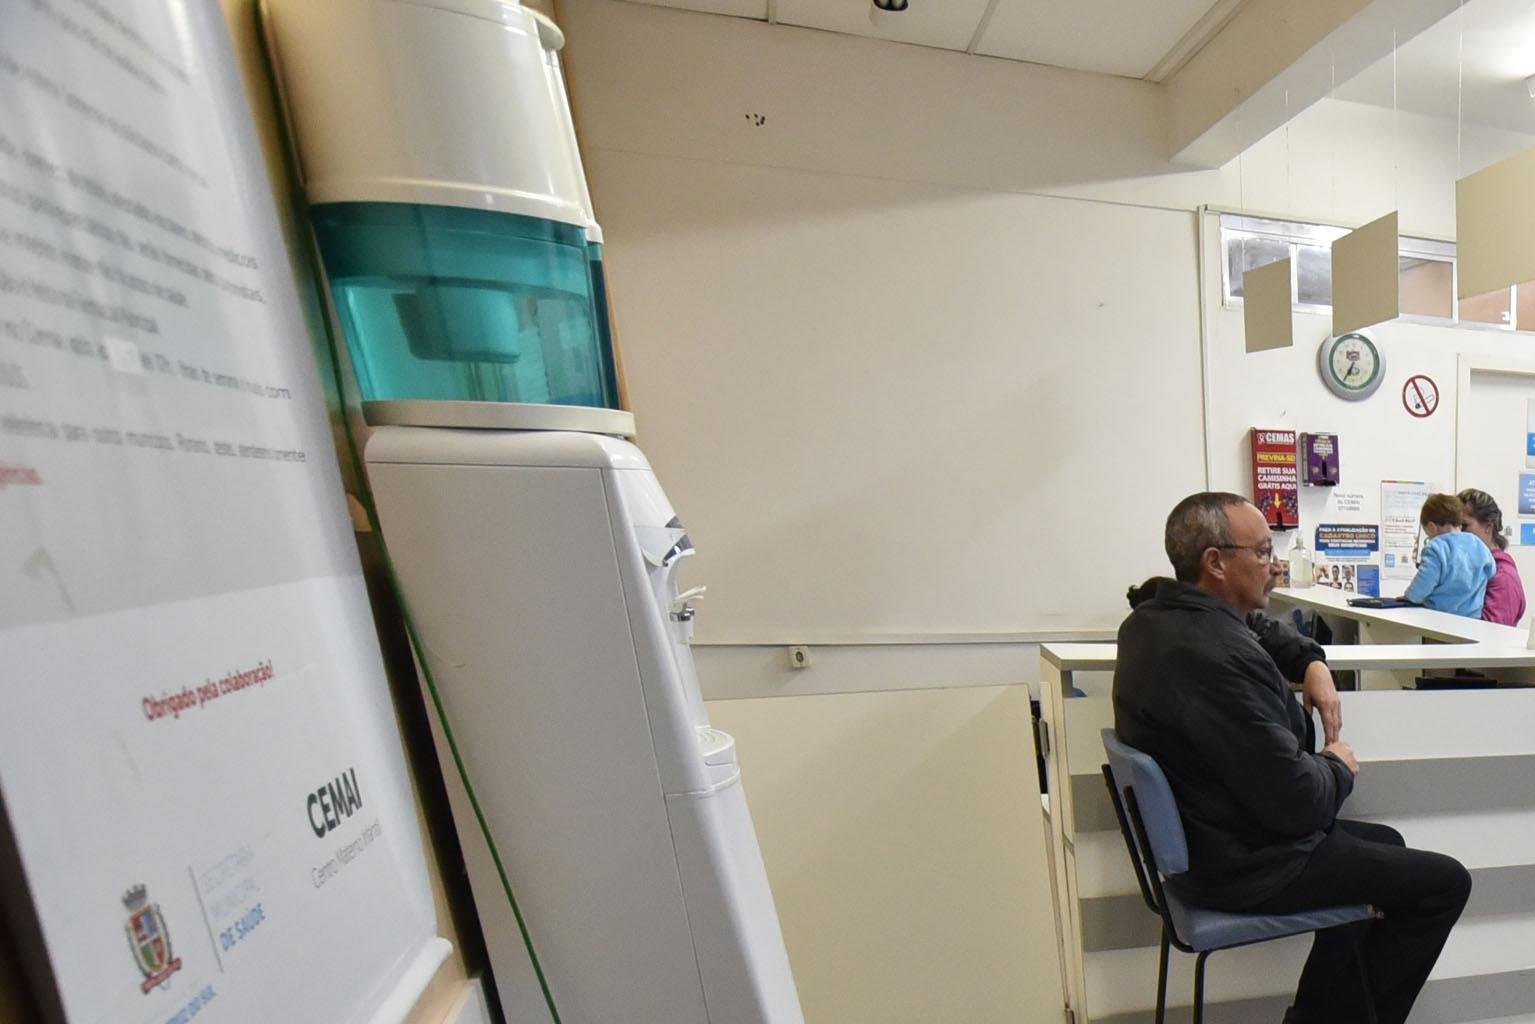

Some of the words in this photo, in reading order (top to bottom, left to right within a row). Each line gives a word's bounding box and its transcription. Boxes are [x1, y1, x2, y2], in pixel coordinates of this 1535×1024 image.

[1266, 432, 1295, 443] CEMAS
[1281, 482, 1297, 490] AQUI
[142, 685, 197, 721] Obrigado
[196, 677, 220, 710] pela
[219, 658, 274, 696] colaboração!
[306, 766, 363, 839] CEMAI
